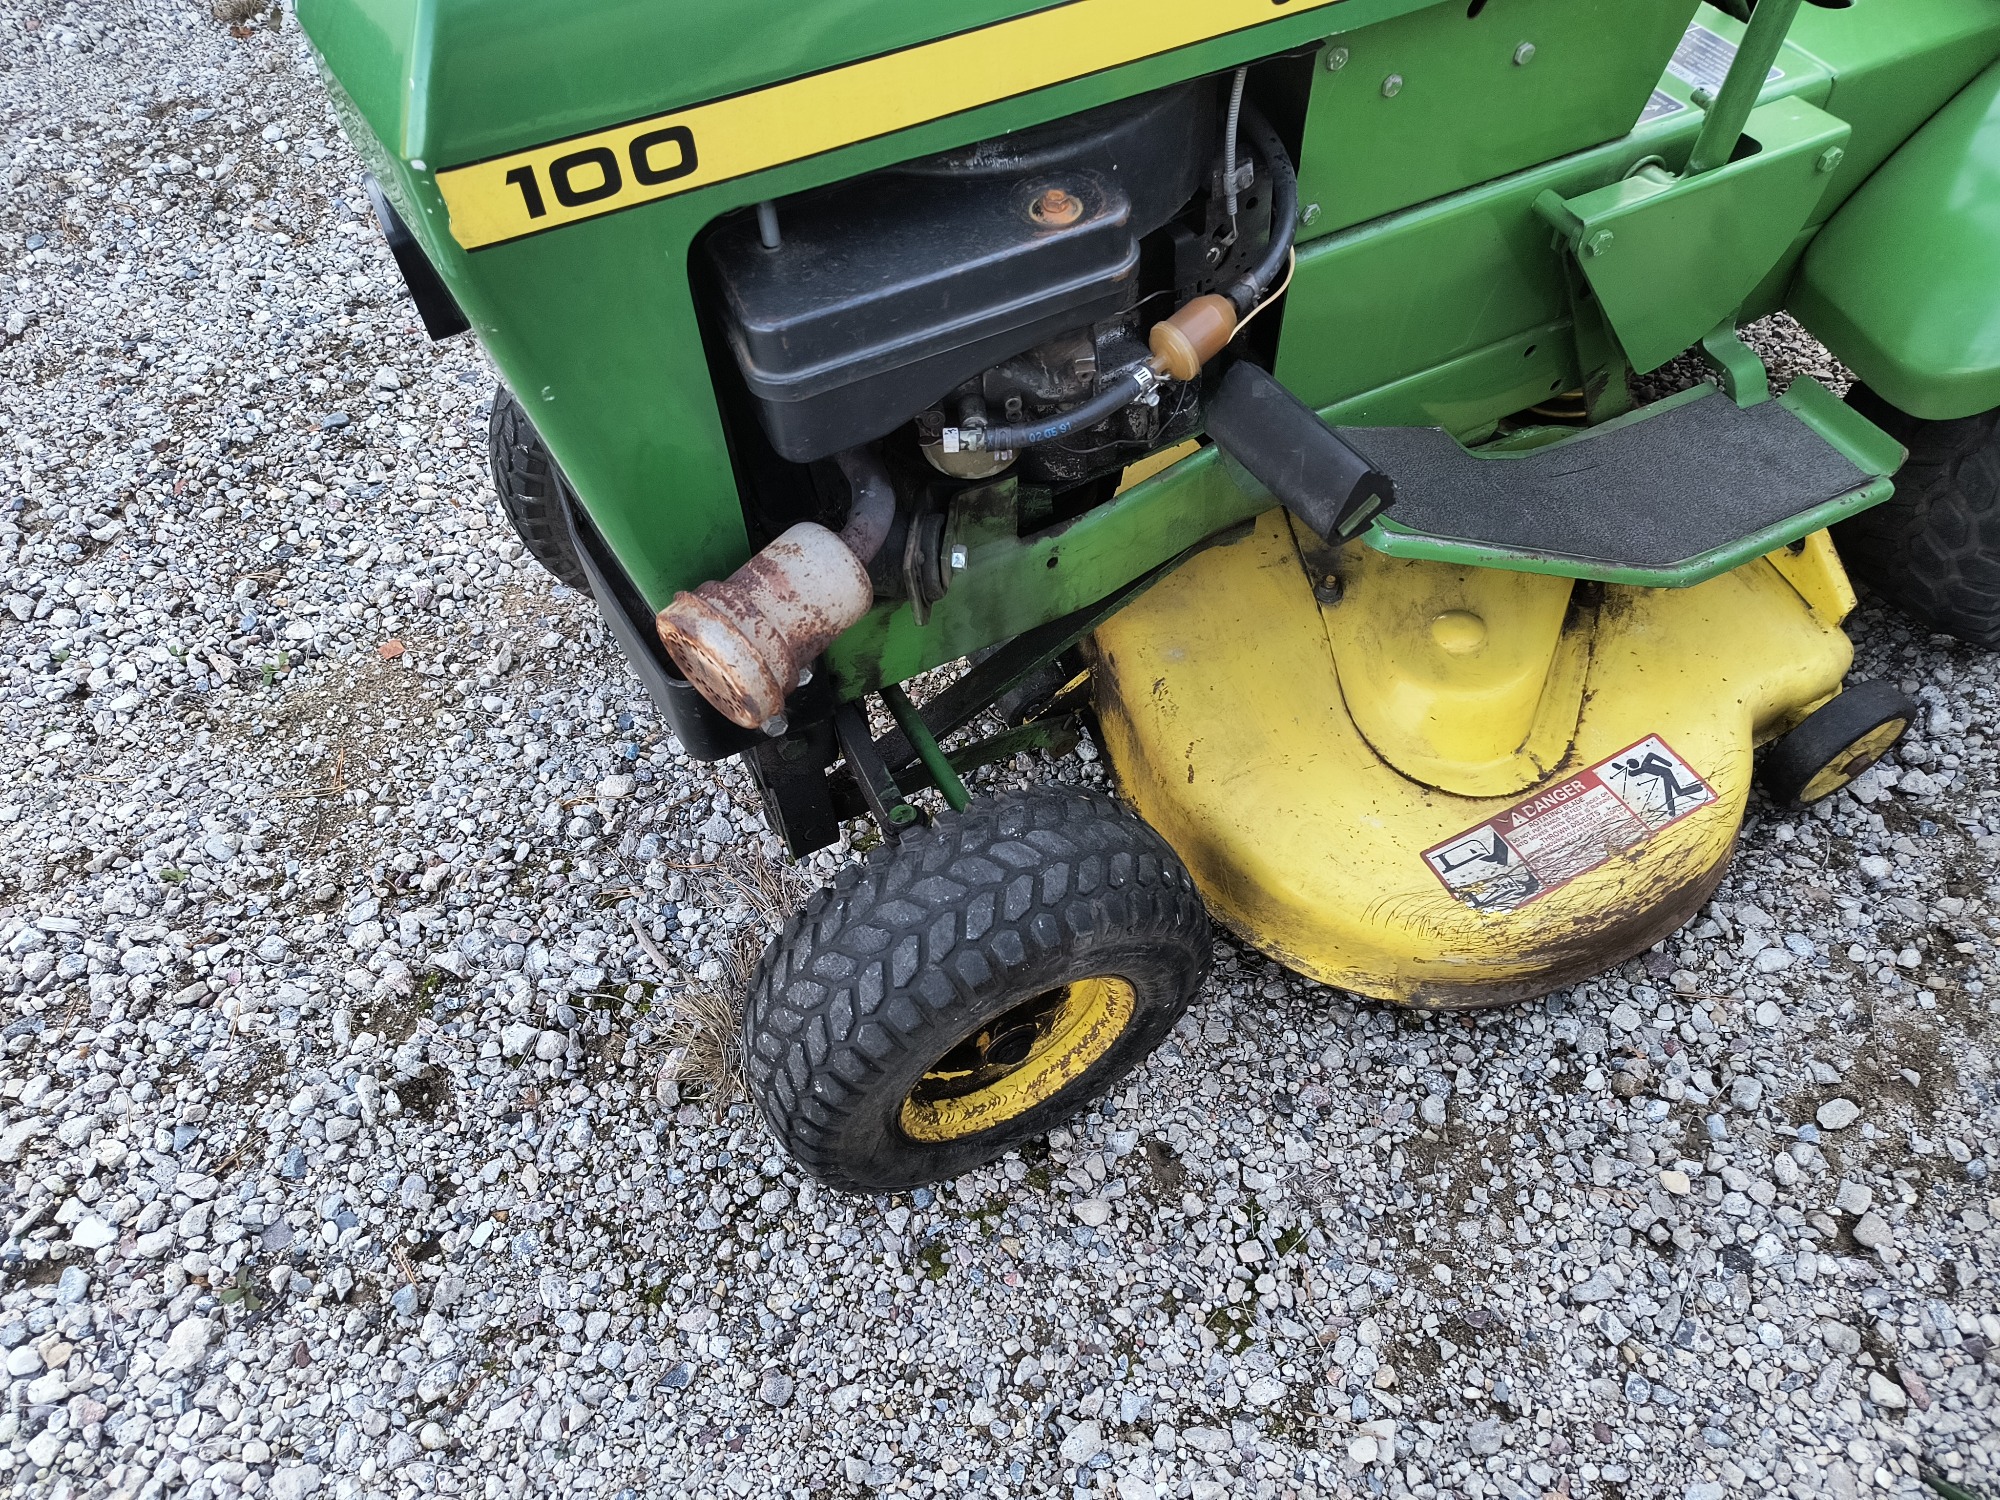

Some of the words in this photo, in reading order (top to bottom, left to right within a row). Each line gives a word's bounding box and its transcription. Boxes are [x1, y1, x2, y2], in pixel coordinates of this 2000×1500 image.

[506, 126, 698, 219] 100
[1521, 778, 1586, 818] DANGER
[1527, 807, 1563, 828] ROTATING
[1561, 796, 1585, 810] BLADE
[1519, 831, 1531, 839] NOT
[1531, 825, 1542, 833] PUT
[1541, 815, 1560, 827] HANDS
[1528, 828, 1549, 841] MOWER
[1549, 819, 1565, 830] WHEN
[1539, 824, 1570, 844] THROWN
[1569, 809, 1601, 829] OBJECTS
